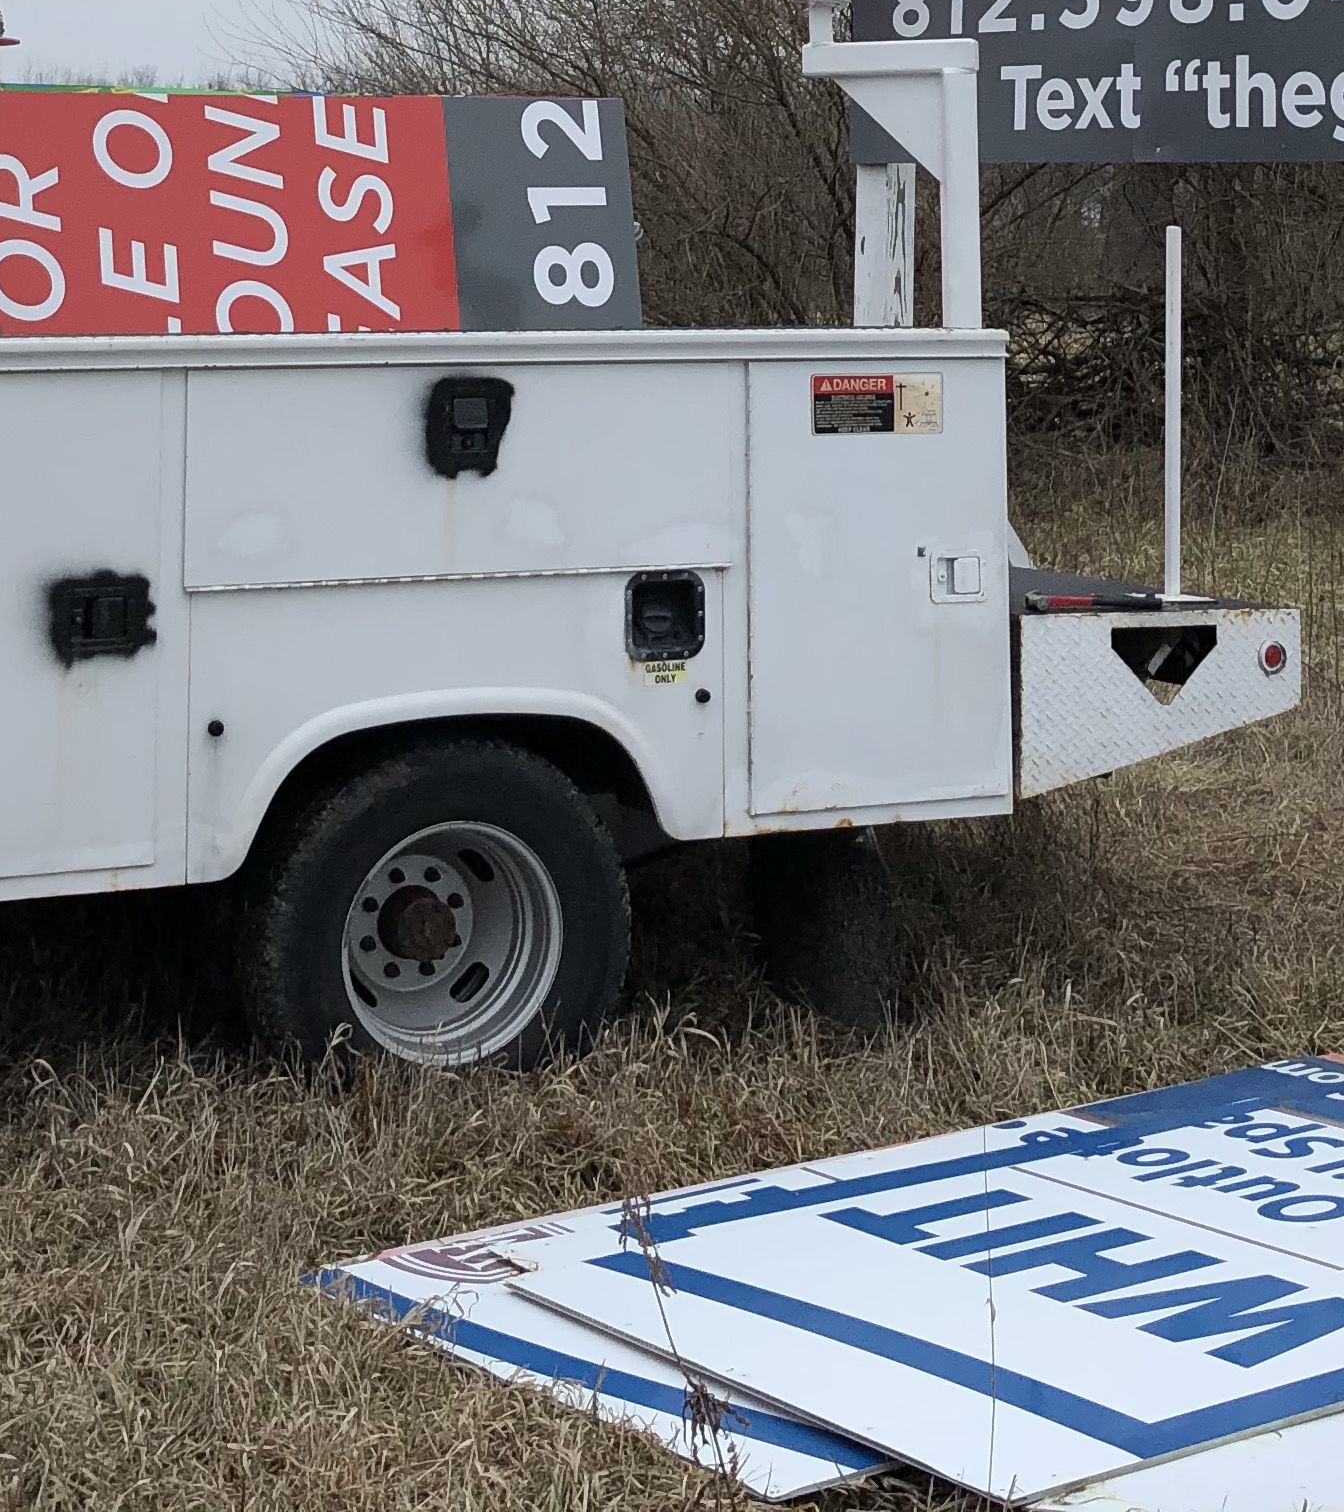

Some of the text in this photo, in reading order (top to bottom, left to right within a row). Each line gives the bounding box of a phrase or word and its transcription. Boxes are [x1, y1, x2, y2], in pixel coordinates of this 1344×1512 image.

[1000, 62, 1142, 131] Text
[93, 94, 182, 333] E O
[204, 95, 295, 333] OUN
[521, 100, 614, 307] 812
[834, 378, 887, 390] DANGER
[645, 662, 686, 673] GASOLINE
[655, 673, 676, 684] ONLY
